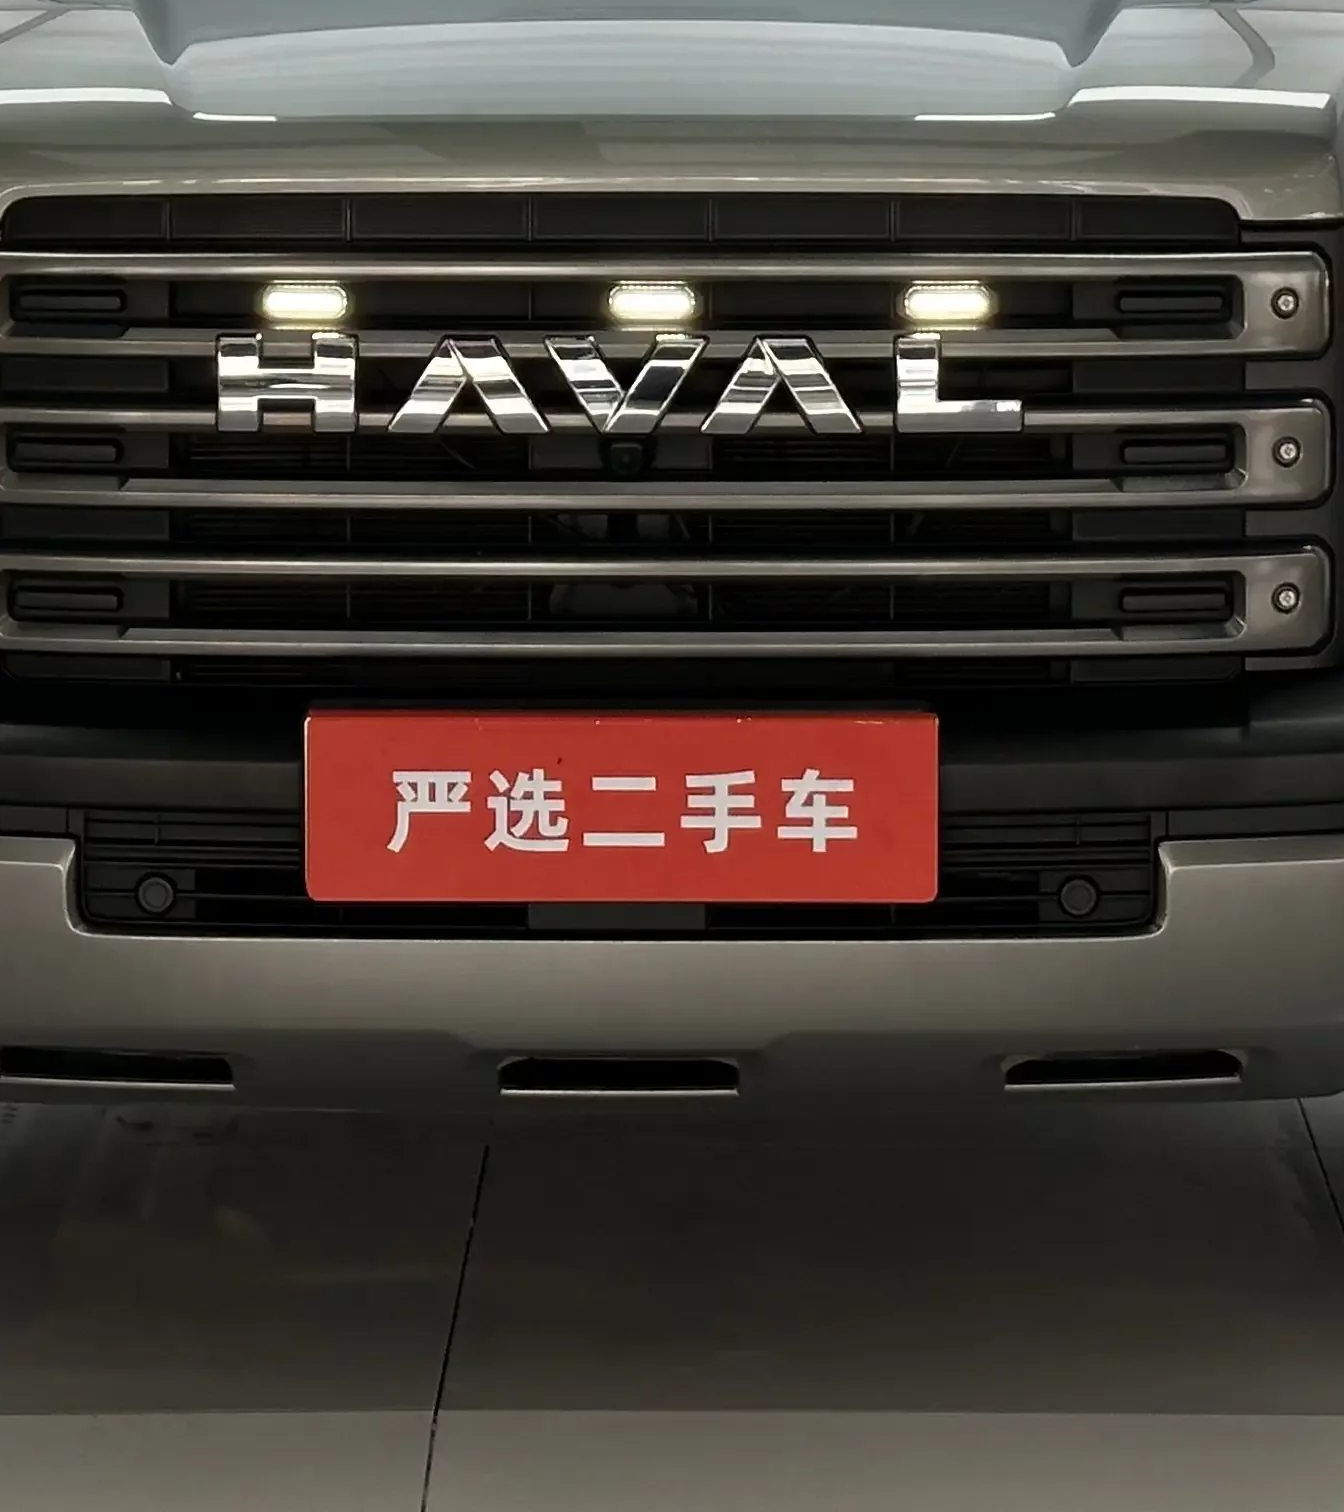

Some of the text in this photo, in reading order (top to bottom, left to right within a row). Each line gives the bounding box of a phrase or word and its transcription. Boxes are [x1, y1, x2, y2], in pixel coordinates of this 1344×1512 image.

[217, 333, 1023, 433] HAVAL
[386, 768, 858, 854] 严选二手车
